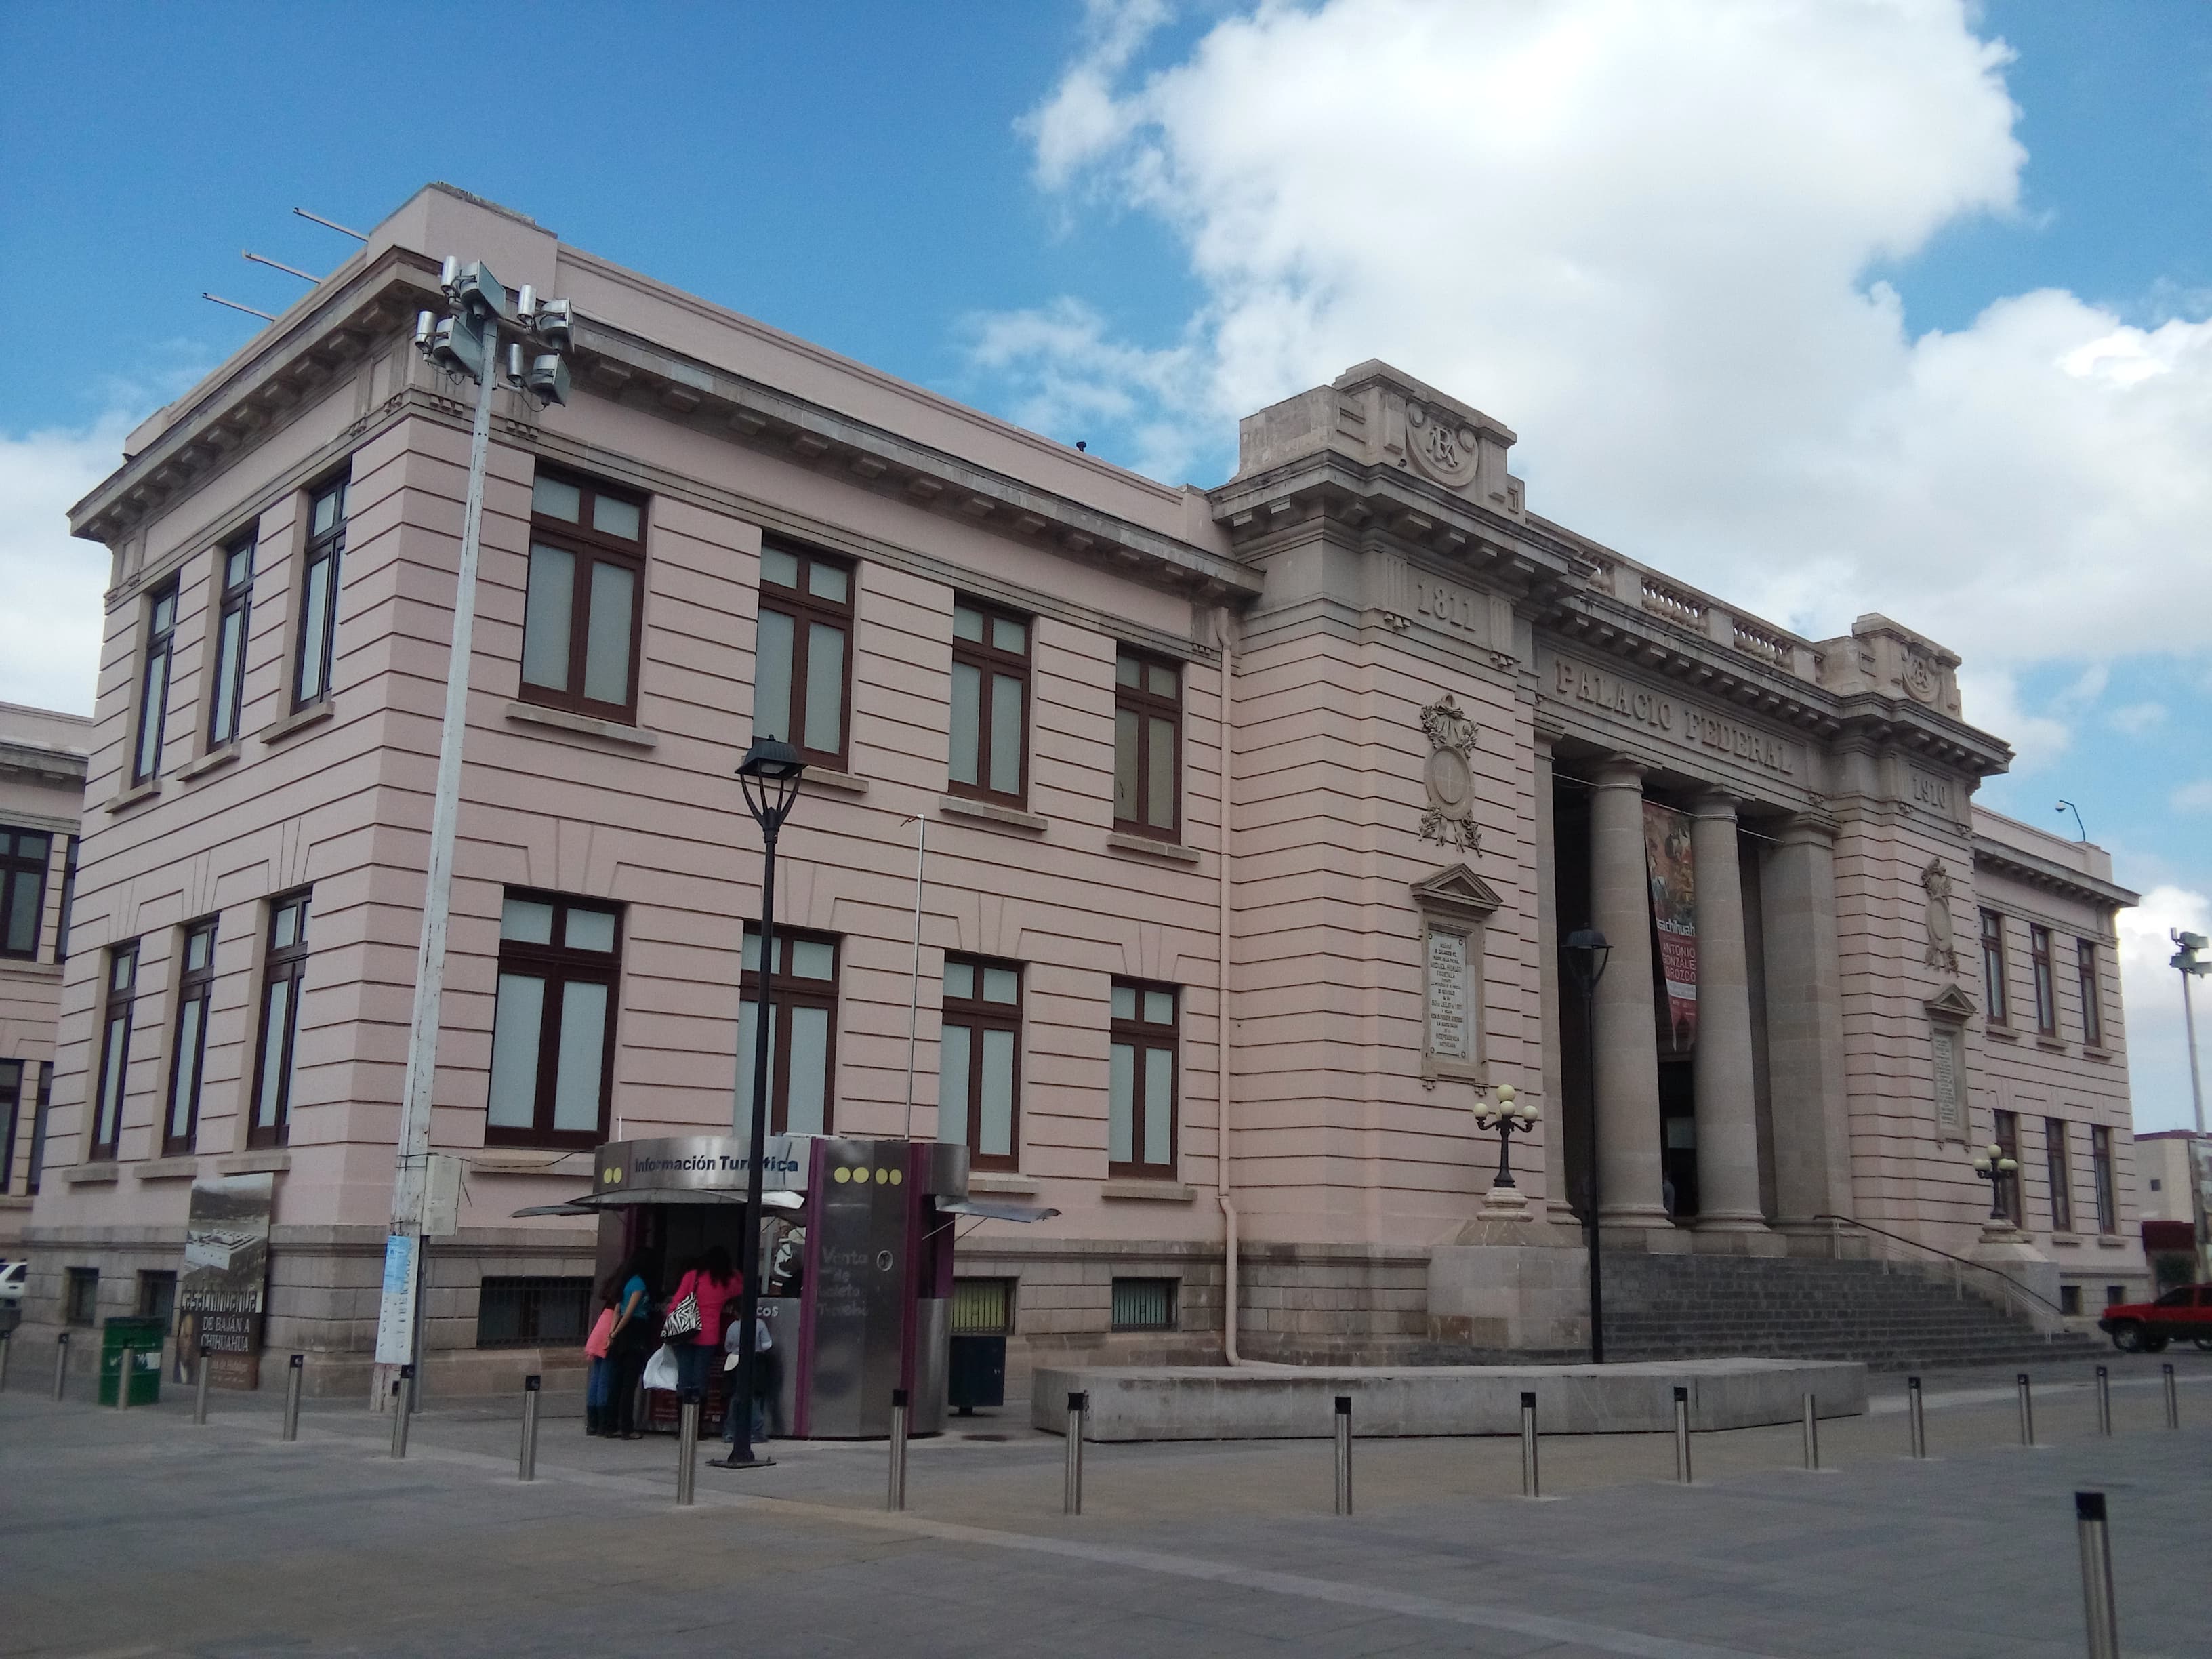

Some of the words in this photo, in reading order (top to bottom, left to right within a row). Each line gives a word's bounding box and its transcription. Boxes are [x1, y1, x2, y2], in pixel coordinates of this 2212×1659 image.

[1418, 581, 1476, 632] 1811
[1556, 661, 1672, 730] PALACIO
[1685, 710, 1795, 775] FEDERAL
[1912, 773, 1946, 808] 1910
[1663, 943, 1696, 958] ANTONIO
[1662, 953, 1697, 970] GONZALE
[1666, 966, 1696, 982] OROZCO
[635, 1155, 716, 1173] Información
[720, 1155, 798, 1172] Turtica
[203, 1317, 214, 1331] DE
[216, 1314, 242, 1332] BAJÁN
[244, 1318, 249, 1333] A
[201, 1333, 249, 1352] CHIHUAHUA
